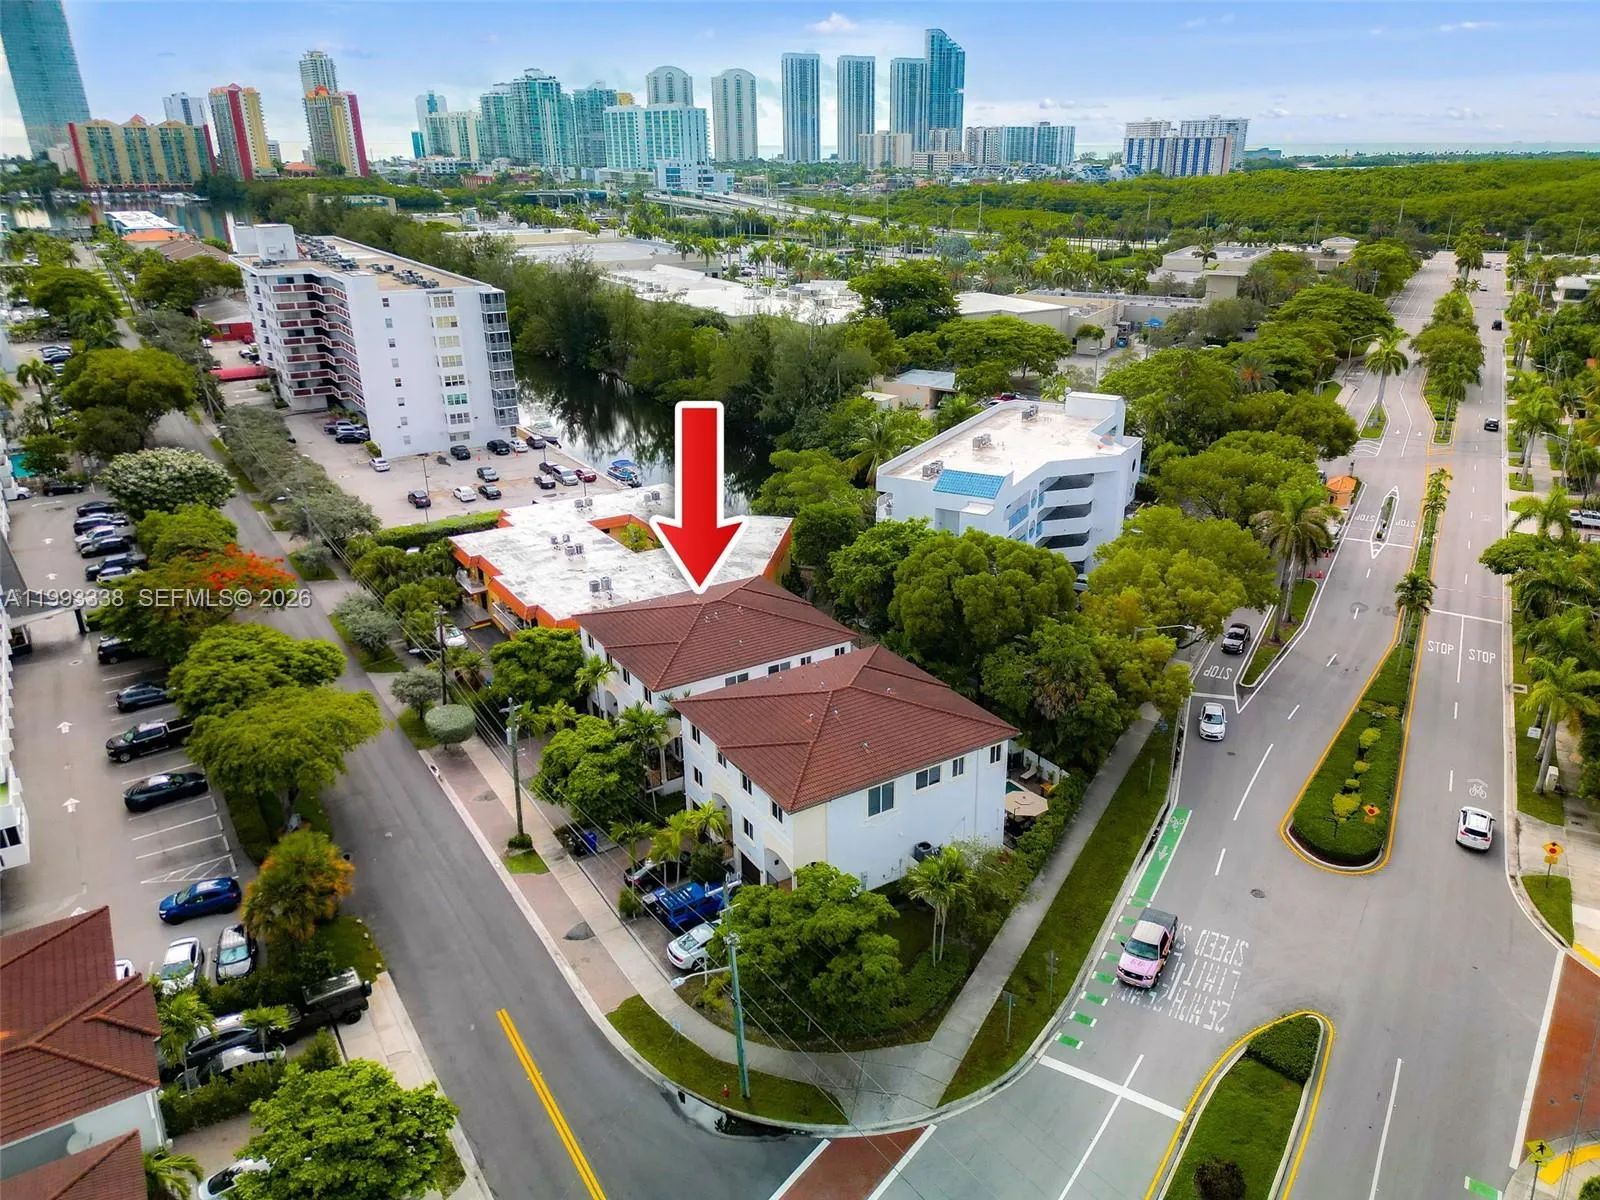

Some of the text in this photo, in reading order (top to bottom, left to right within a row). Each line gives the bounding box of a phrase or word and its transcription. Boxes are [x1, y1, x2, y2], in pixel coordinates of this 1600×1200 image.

[1395, 519, 1417, 528] STOP
[1427, 640, 1454, 655] STOP
[1468, 648, 1496, 664] STOP
[1203, 664, 1233, 680] STOP
[1194, 929, 1249, 967] SPEED
[1182, 958, 1241, 1001] LIMIT
[1168, 987, 1208, 1026] MPH
[1203, 1000, 1231, 1033] 25
